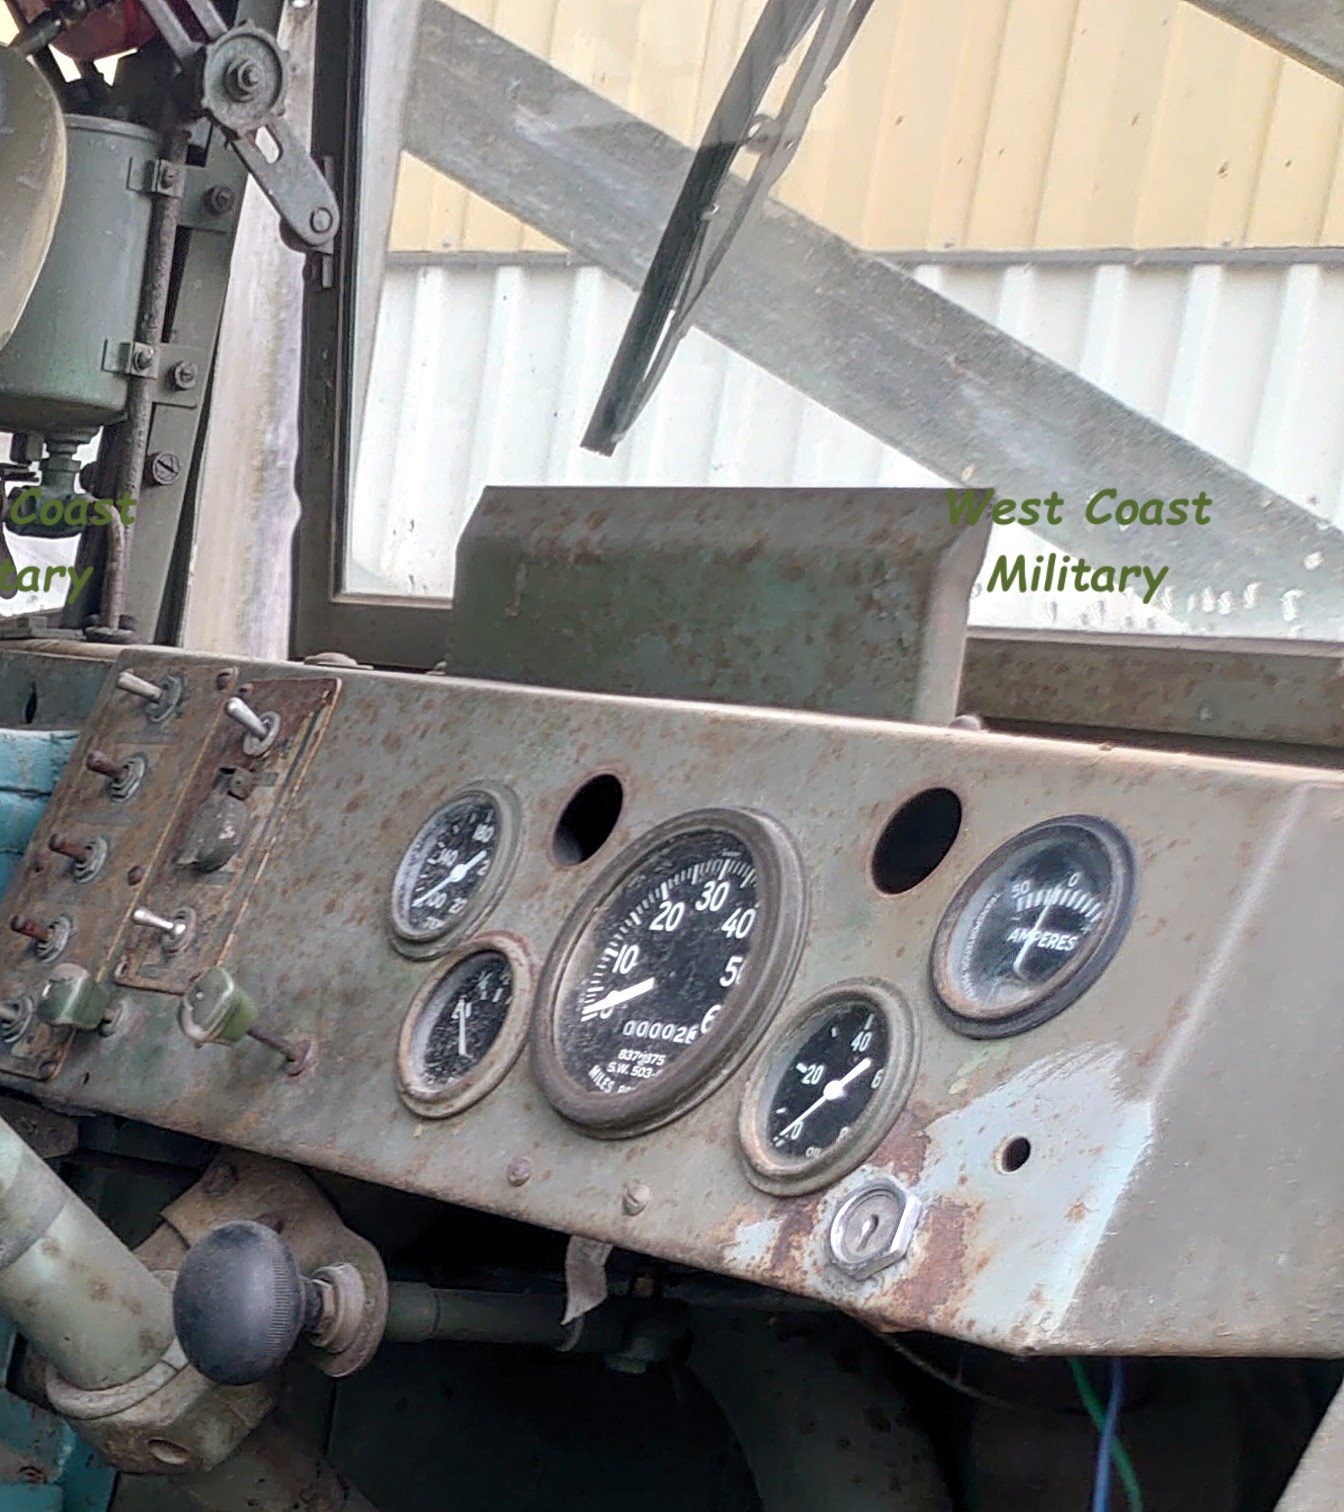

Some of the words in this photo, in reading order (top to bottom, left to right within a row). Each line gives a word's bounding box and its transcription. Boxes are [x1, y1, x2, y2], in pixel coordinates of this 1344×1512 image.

[695, 880, 730, 912] 30
[649, 901, 685, 931] 20
[721, 907, 757, 939] 40
[1006, 927, 1080, 952] AMPERES
[612, 943, 640, 974] 10
[719, 955, 746, 987] 5
[850, 1031, 873, 1052] 40
[588, 1064, 616, 1094] MILES
[801, 1063, 825, 1085] 20
